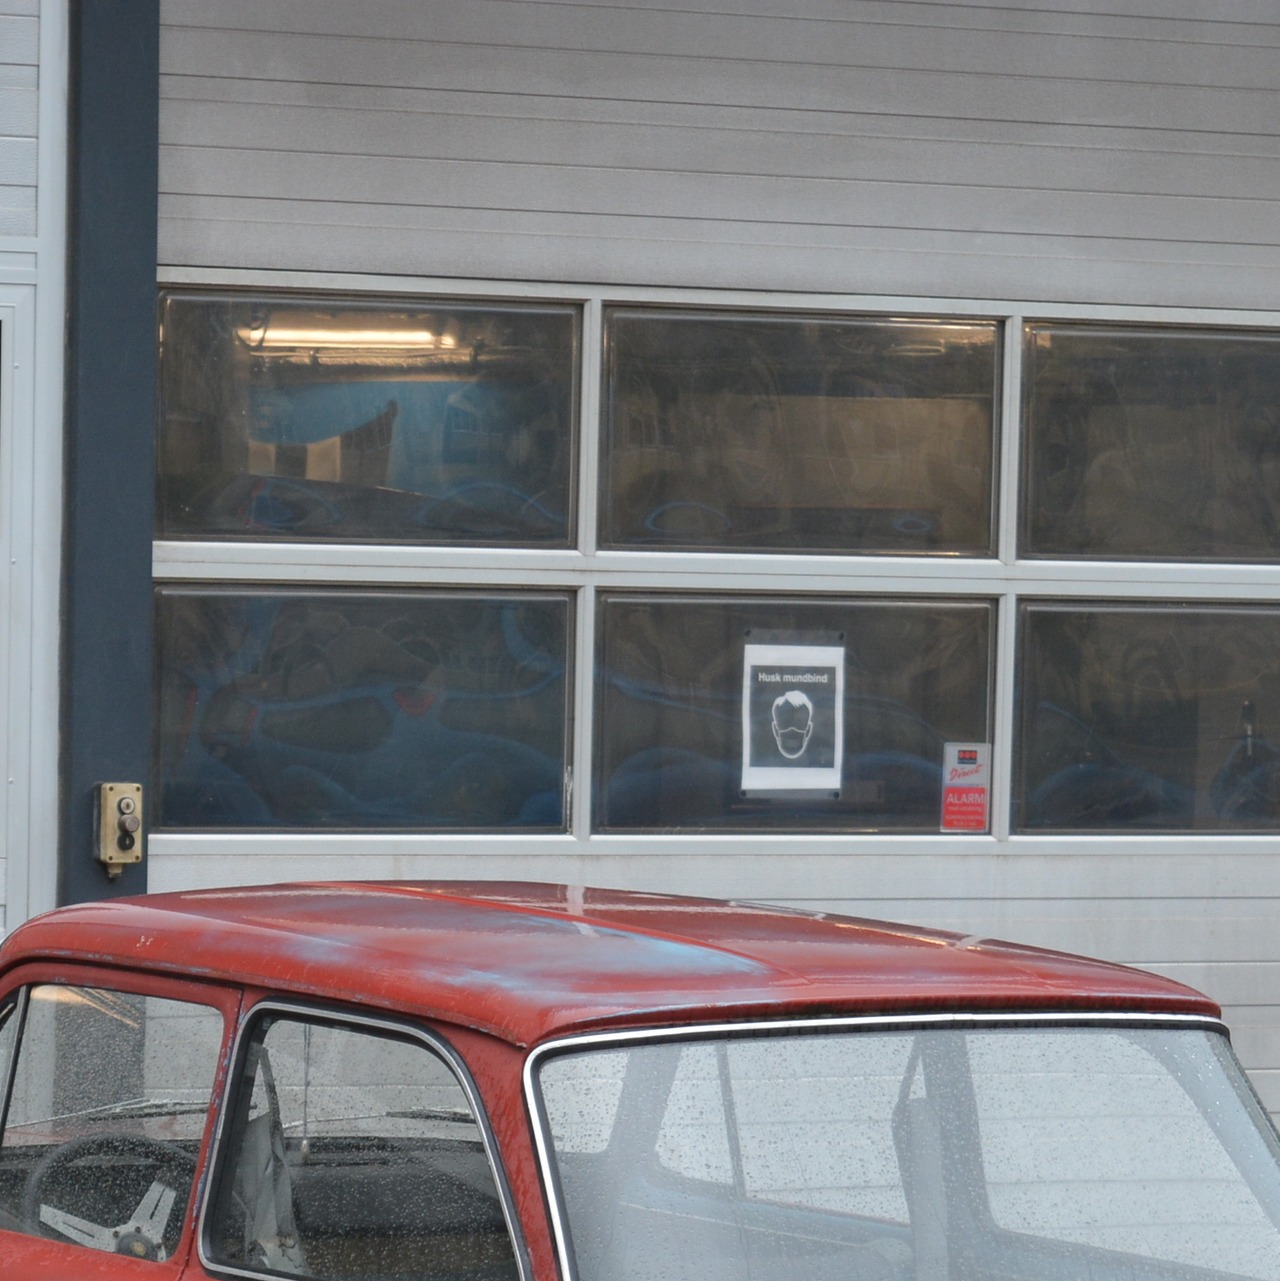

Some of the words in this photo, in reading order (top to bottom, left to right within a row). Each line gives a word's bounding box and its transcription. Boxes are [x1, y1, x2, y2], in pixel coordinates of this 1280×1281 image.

[758, 672, 781, 683] Husk
[783, 673, 828, 684] mundbind
[946, 792, 985, 804] ALARM
